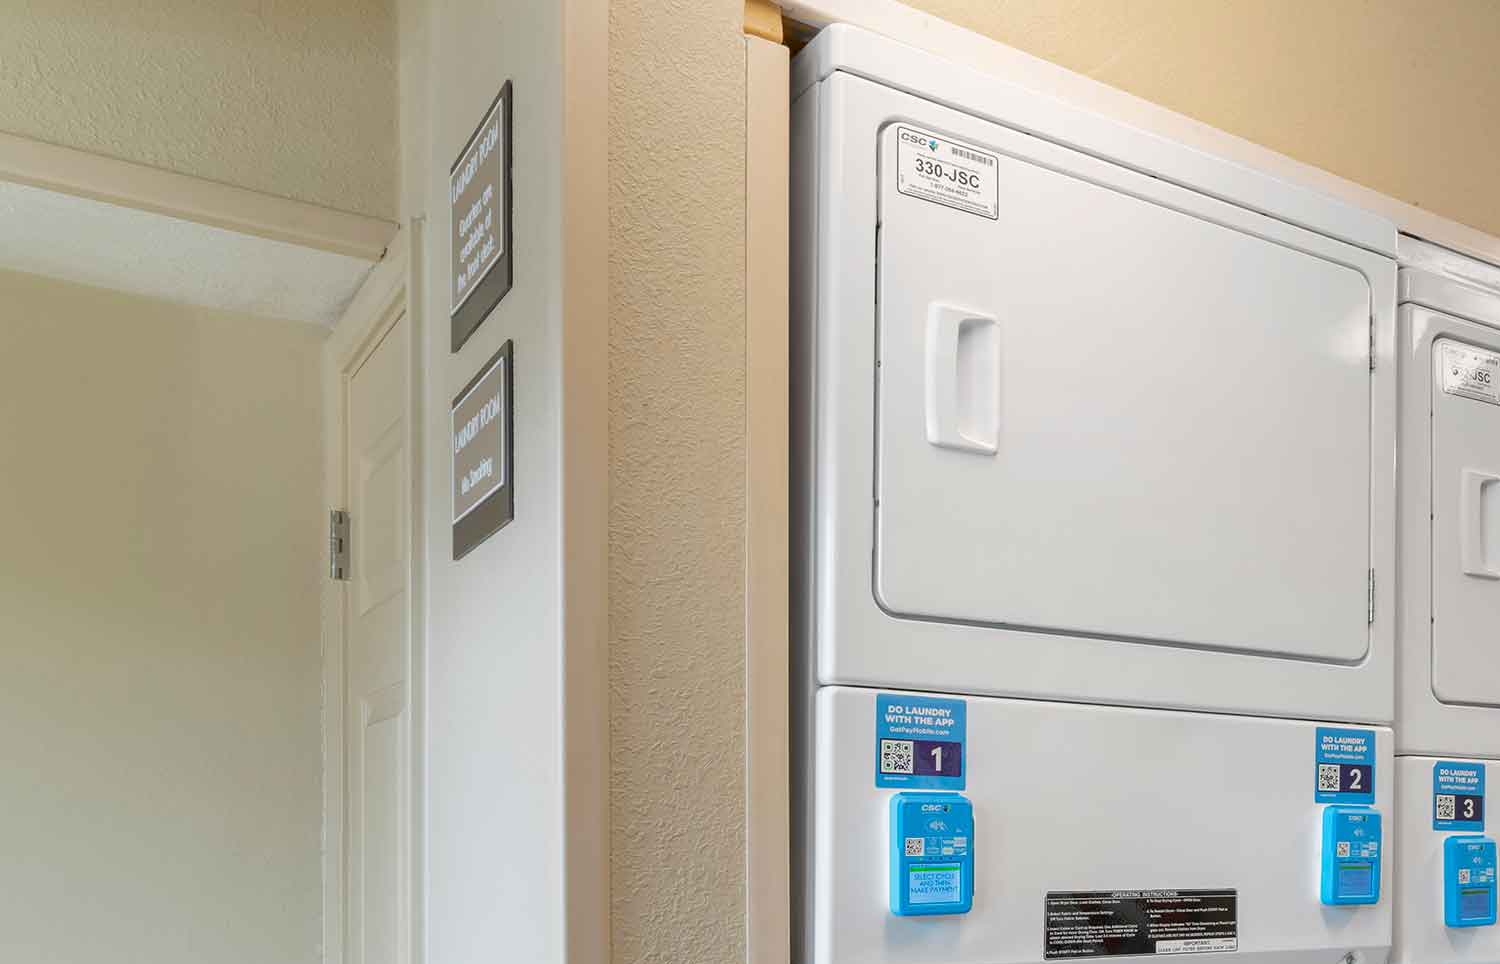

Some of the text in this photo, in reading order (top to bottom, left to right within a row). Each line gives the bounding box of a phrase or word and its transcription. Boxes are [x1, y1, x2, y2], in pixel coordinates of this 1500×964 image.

[901, 132, 927, 146] CSC
[915, 158, 980, 189] 330-JSC
[455, 391, 501, 454] LAUNDRY ROOM
[888, 705, 952, 718] DO LAUNDRY
[885, 714, 955, 727] WITH THE APP
[1321, 743, 1340, 751] WITH
[1340, 744, 1353, 752] THE
[1322, 736, 1366, 745] DO LAUNDRY
[930, 746, 942, 772] 1
[1349, 768, 1361, 790] 2
[1463, 798, 1474, 818] 3
